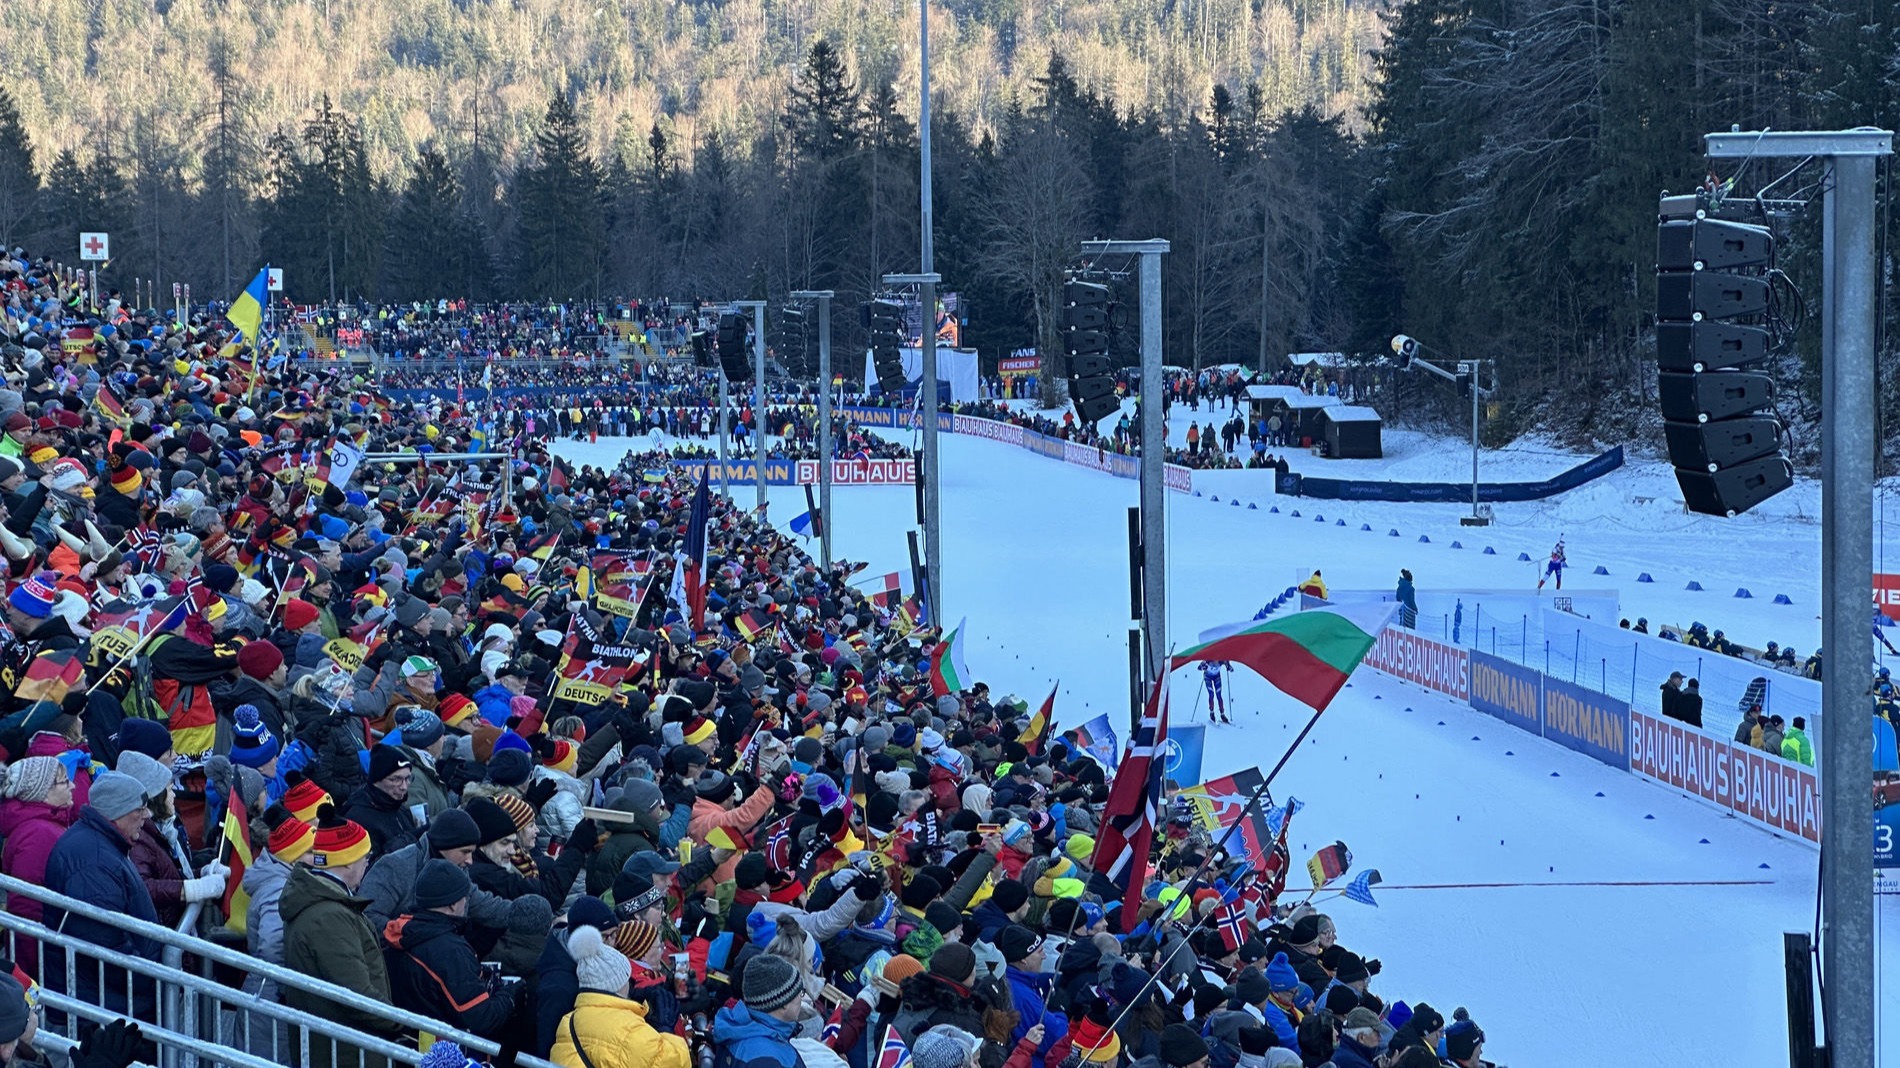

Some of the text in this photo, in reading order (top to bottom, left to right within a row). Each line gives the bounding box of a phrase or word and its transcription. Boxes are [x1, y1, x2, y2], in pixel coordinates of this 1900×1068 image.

[1002, 360, 1035, 369] FISCHER
[1010, 348, 1036, 358] FANS
[954, 418, 993, 437] BAUHAUS
[800, 464, 915, 480] BUHAUS
[592, 643, 638, 658] BIATHLON
[1406, 641, 1468, 693] BAUHAUS
[1473, 661, 1537, 721] HÖRMANN
[1546, 689, 1624, 755] HÖRMANN
[1632, 720, 1729, 797] BAUHAUS
[1735, 758, 1816, 832] BAUHA
